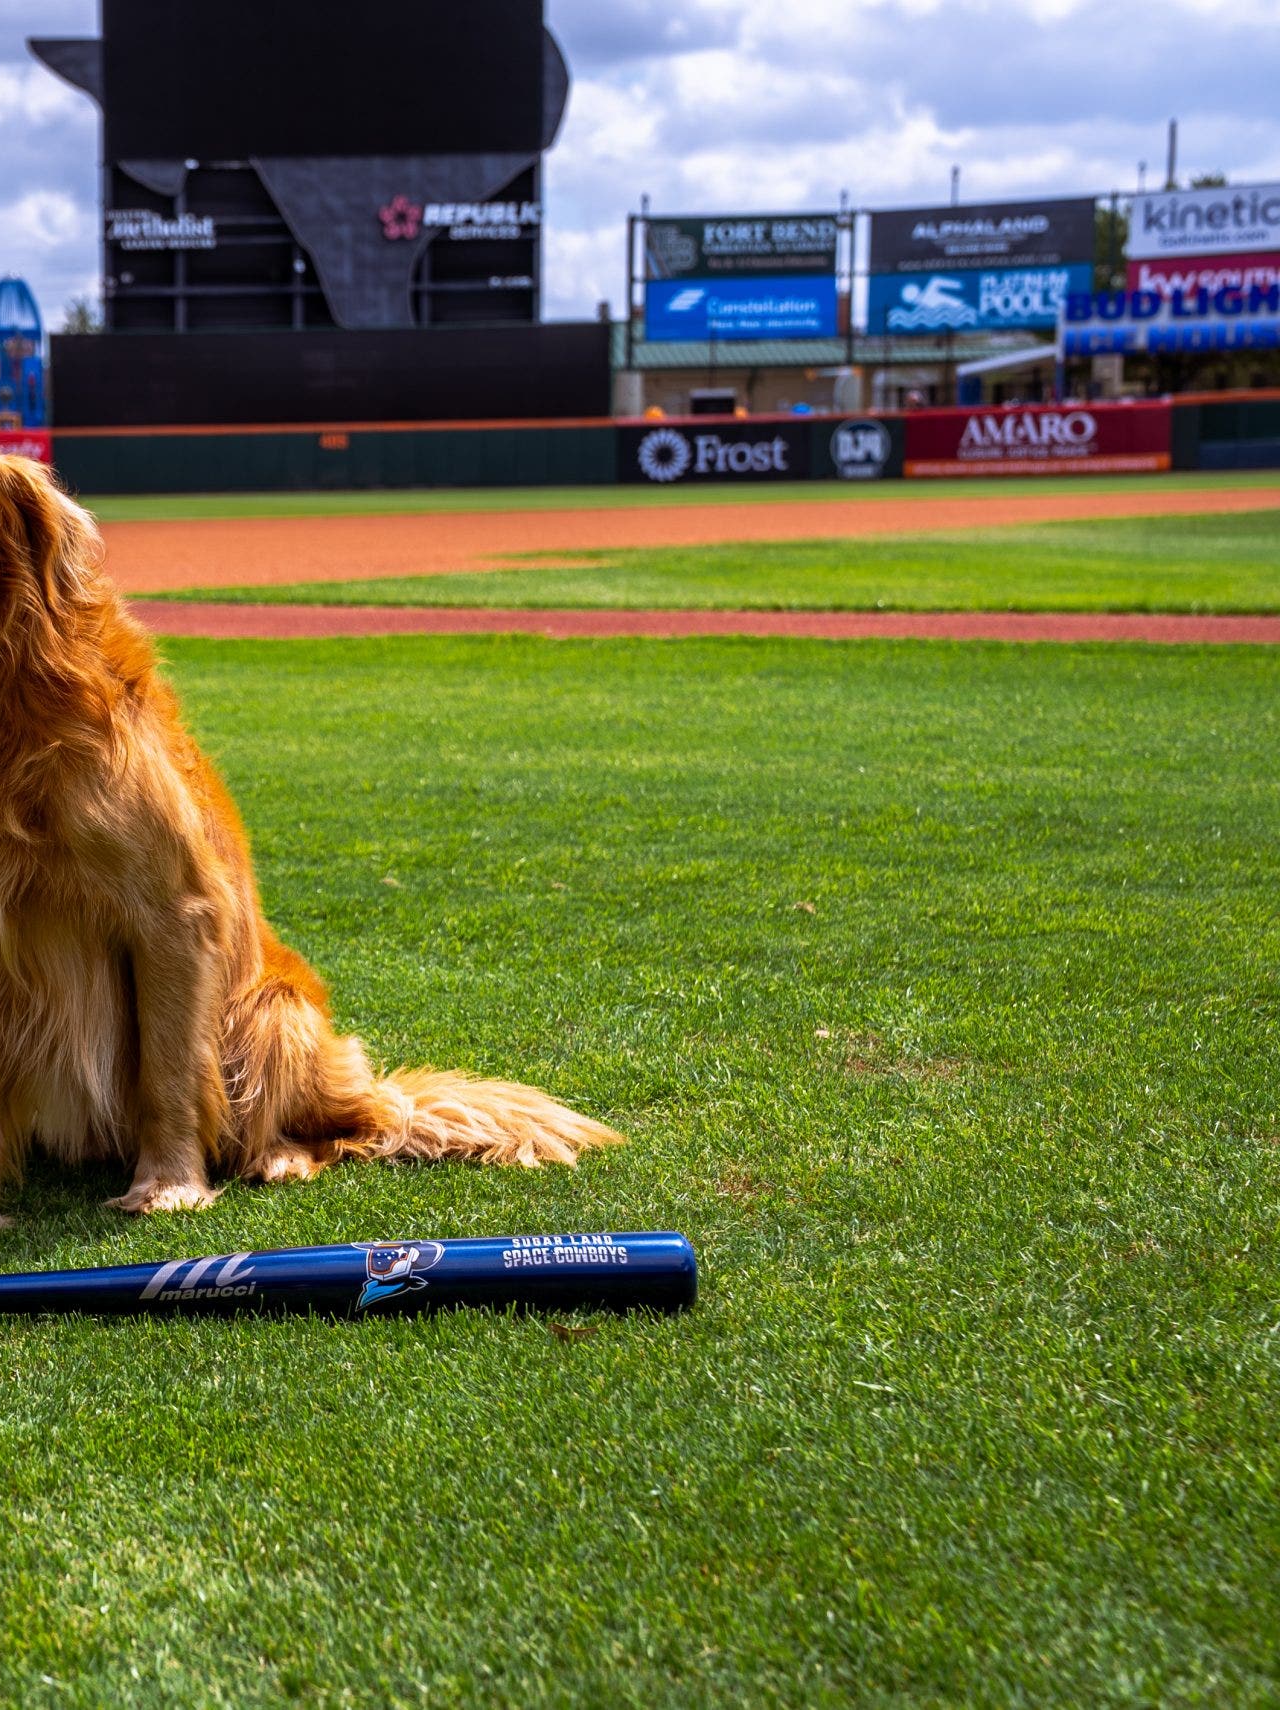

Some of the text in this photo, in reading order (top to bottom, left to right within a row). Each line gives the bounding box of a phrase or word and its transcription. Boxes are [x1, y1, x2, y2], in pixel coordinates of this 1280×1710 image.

[423, 203, 542, 226] REPUBLIC
[1143, 193, 1280, 234] kinetic
[704, 219, 836, 243] FORT BEND
[912, 216, 1050, 239] ALPHALAND
[979, 291, 1067, 319] POOLS
[1066, 291, 1161, 321] BUD
[961, 412, 1097, 447] AMARO
[694, 435, 788, 473] Frost
[512, 1235, 613, 1248] SUGAR LAND
[503, 1246, 628, 1268] SPACE COWBOYS
[159, 1281, 257, 1300] marucci
